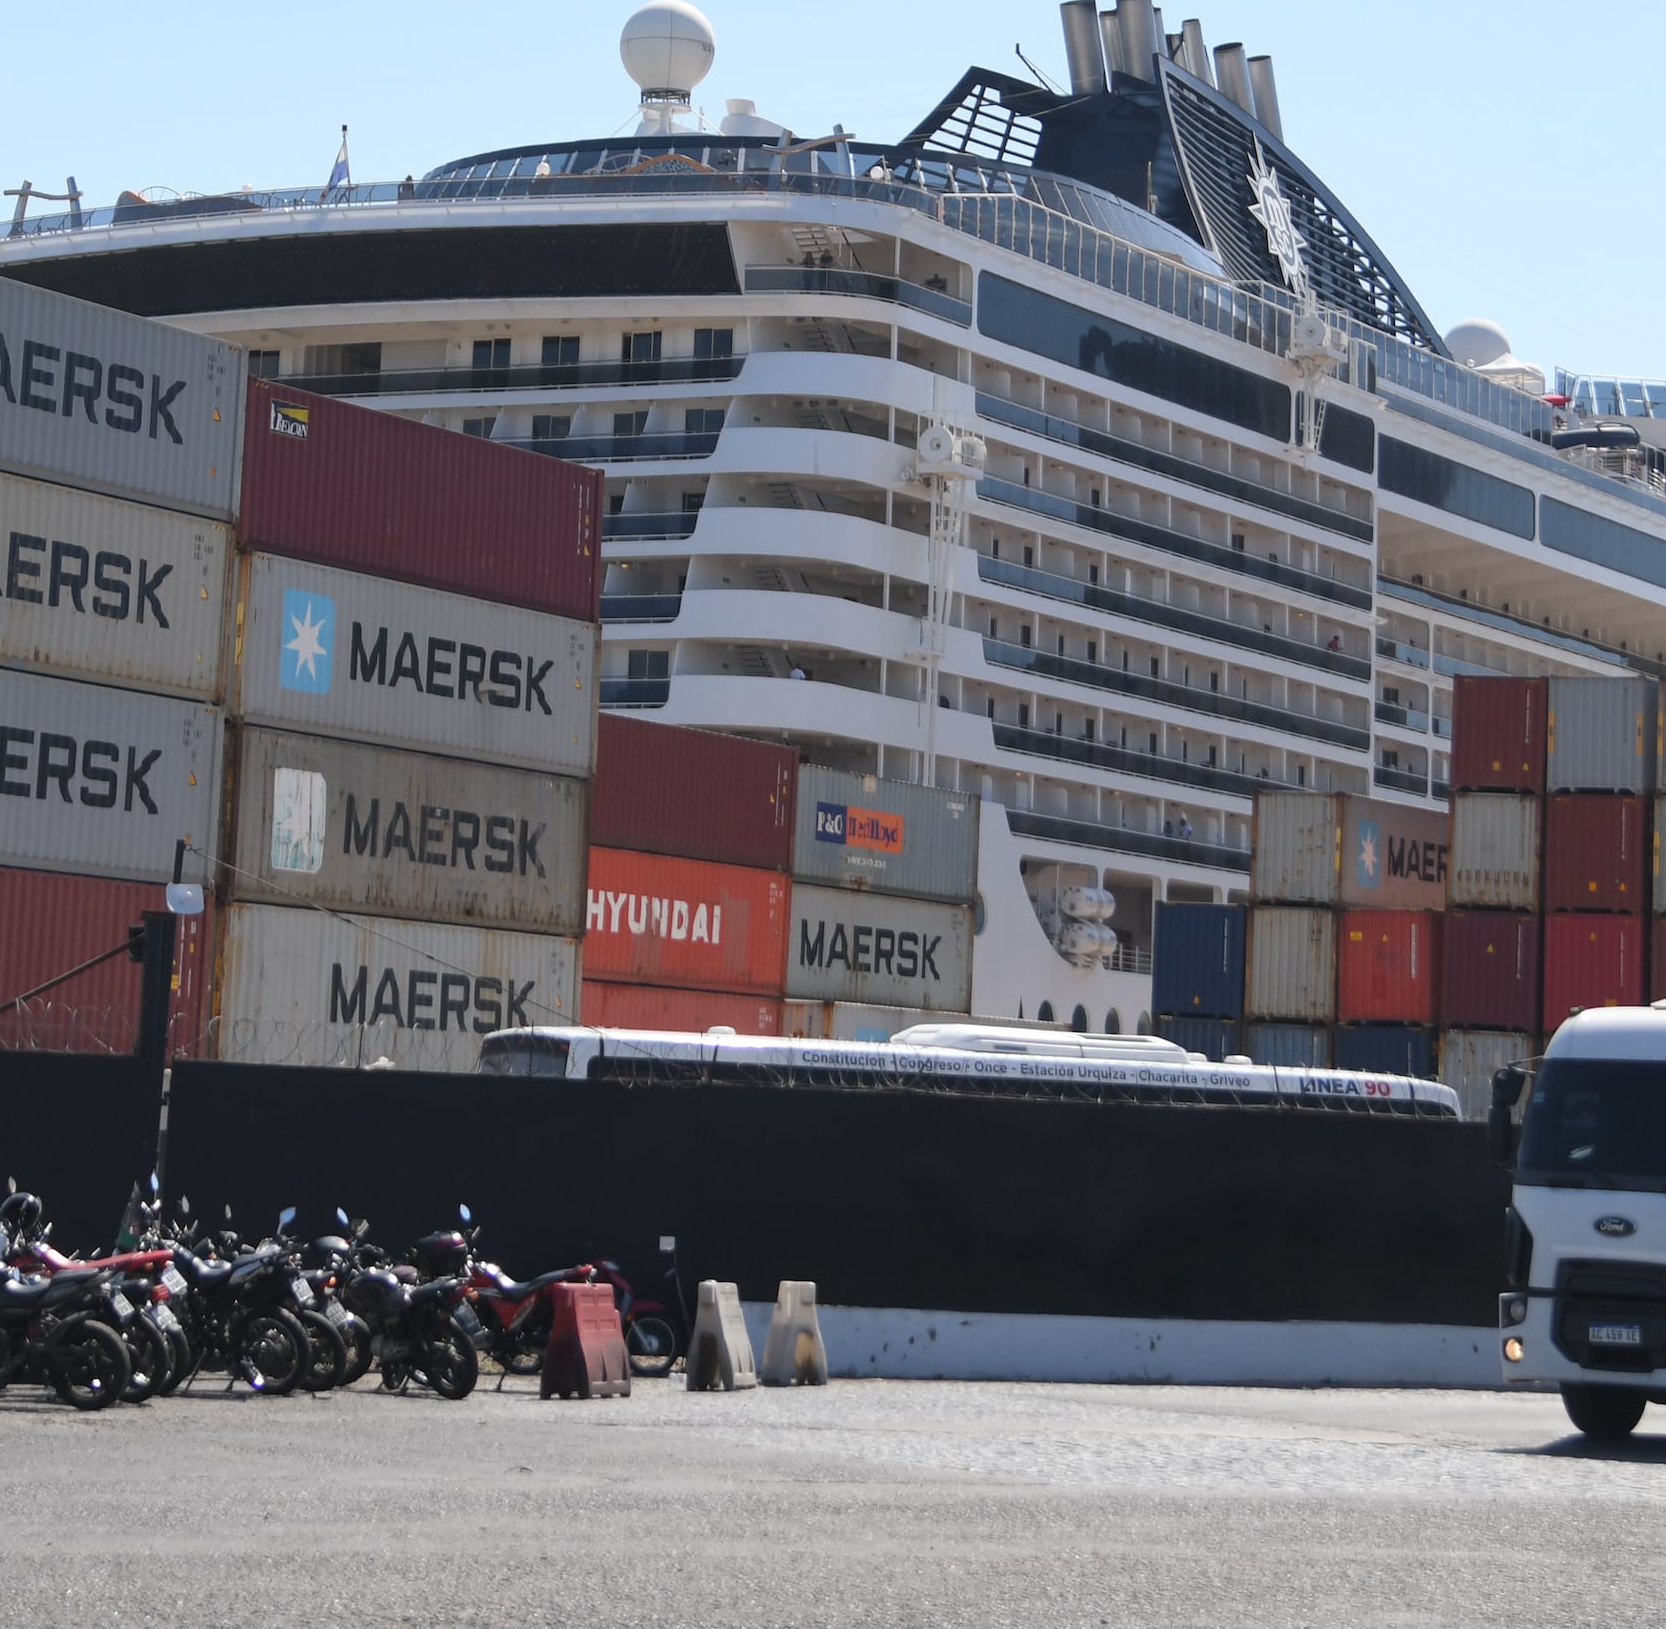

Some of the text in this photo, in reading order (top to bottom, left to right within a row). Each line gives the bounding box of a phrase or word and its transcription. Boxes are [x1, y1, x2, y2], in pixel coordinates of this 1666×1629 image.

[349, 621, 555, 715] MAERSK
[343, 794, 547, 878] MAERSK
[817, 811, 843, 835] P&O
[586, 888, 722, 945] HYUNDAI
[800, 918, 942, 980] MAERSK
[329, 962, 536, 1033] MAERSK
[899, 1056, 960, 1075] Congreso
[974, 1060, 1008, 1073] Once
[1078, 1065, 1127, 1082] Urquiza
[1139, 1069, 1198, 1086] Chacarita
[1209, 1073, 1251, 1088] Griveo
[1364, 1079, 1391, 1097] 90
[1599, 1219, 1625, 1233] Ford
